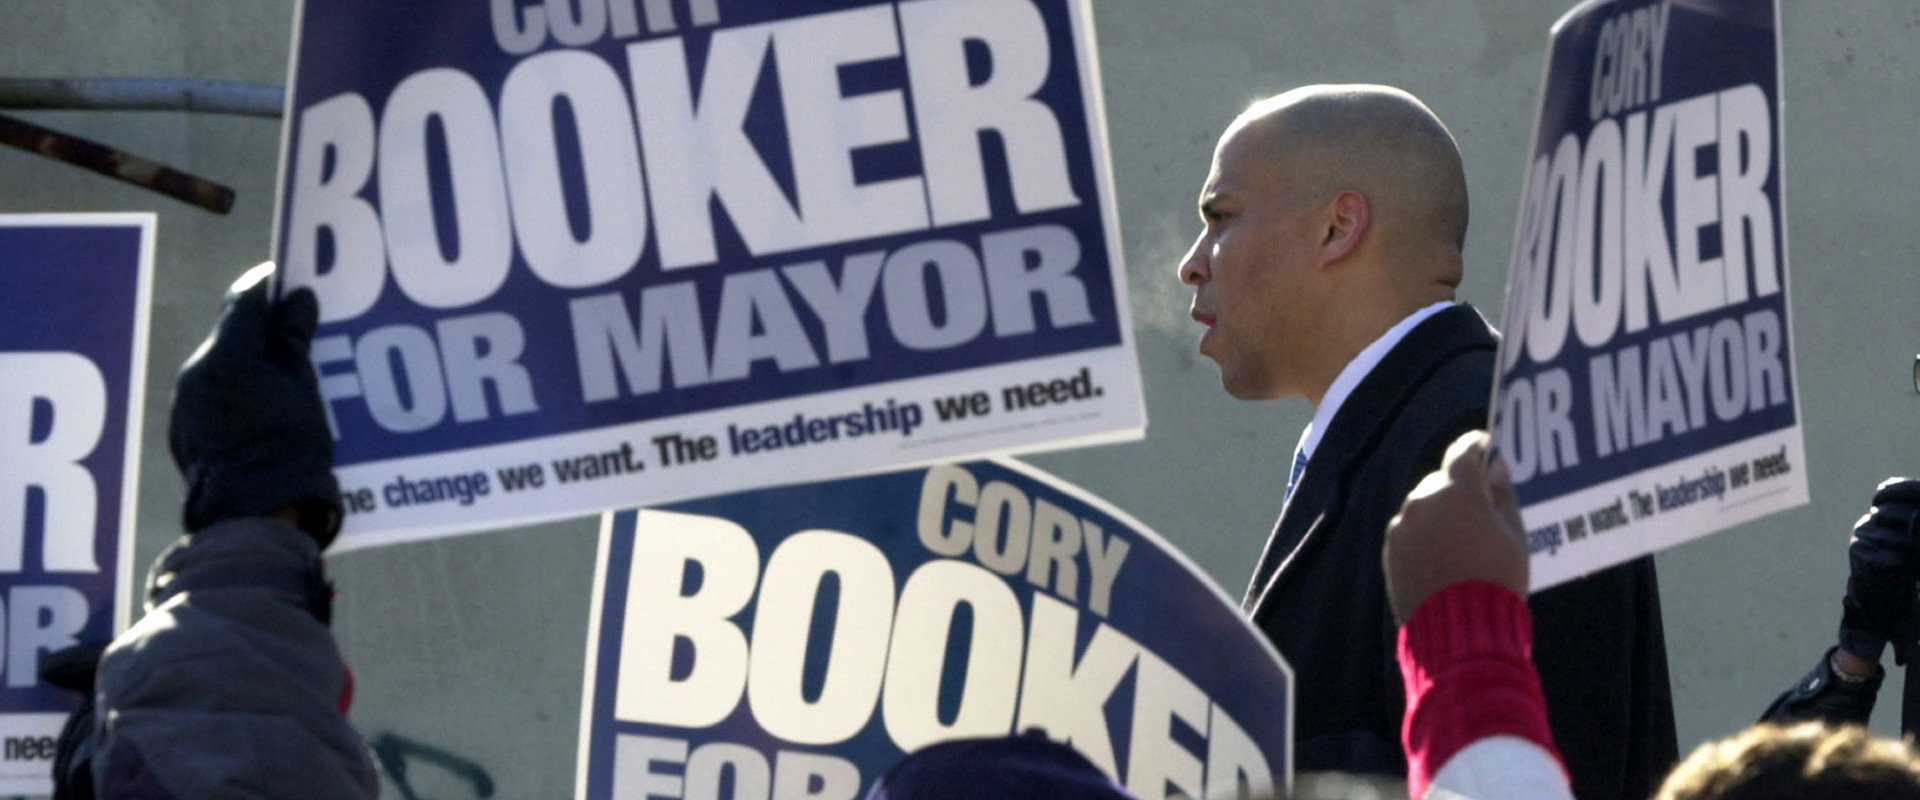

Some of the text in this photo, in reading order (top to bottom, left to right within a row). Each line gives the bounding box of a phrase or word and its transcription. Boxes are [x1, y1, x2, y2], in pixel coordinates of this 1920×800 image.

[1589, 0, 1671, 121] CORY
[280, 0, 1082, 325] BOOKER
[1502, 84, 1779, 374] BOOKER
[310, 224, 1095, 442] FOR MAYOR
[1495, 309, 1786, 484] OR MAYOR
[383, 471, 490, 506] change
[498, 462, 545, 492] we
[553, 441, 646, 484] want.
[652, 433, 718, 468] The
[728, 399, 922, 455] leadership
[934, 390, 990, 423] we
[1002, 367, 1104, 413] need.
[1528, 522, 1562, 555] ange
[1655, 465, 1726, 512] leadership
[917, 463, 1132, 620] CORY
[4, 735, 58, 762] nee
